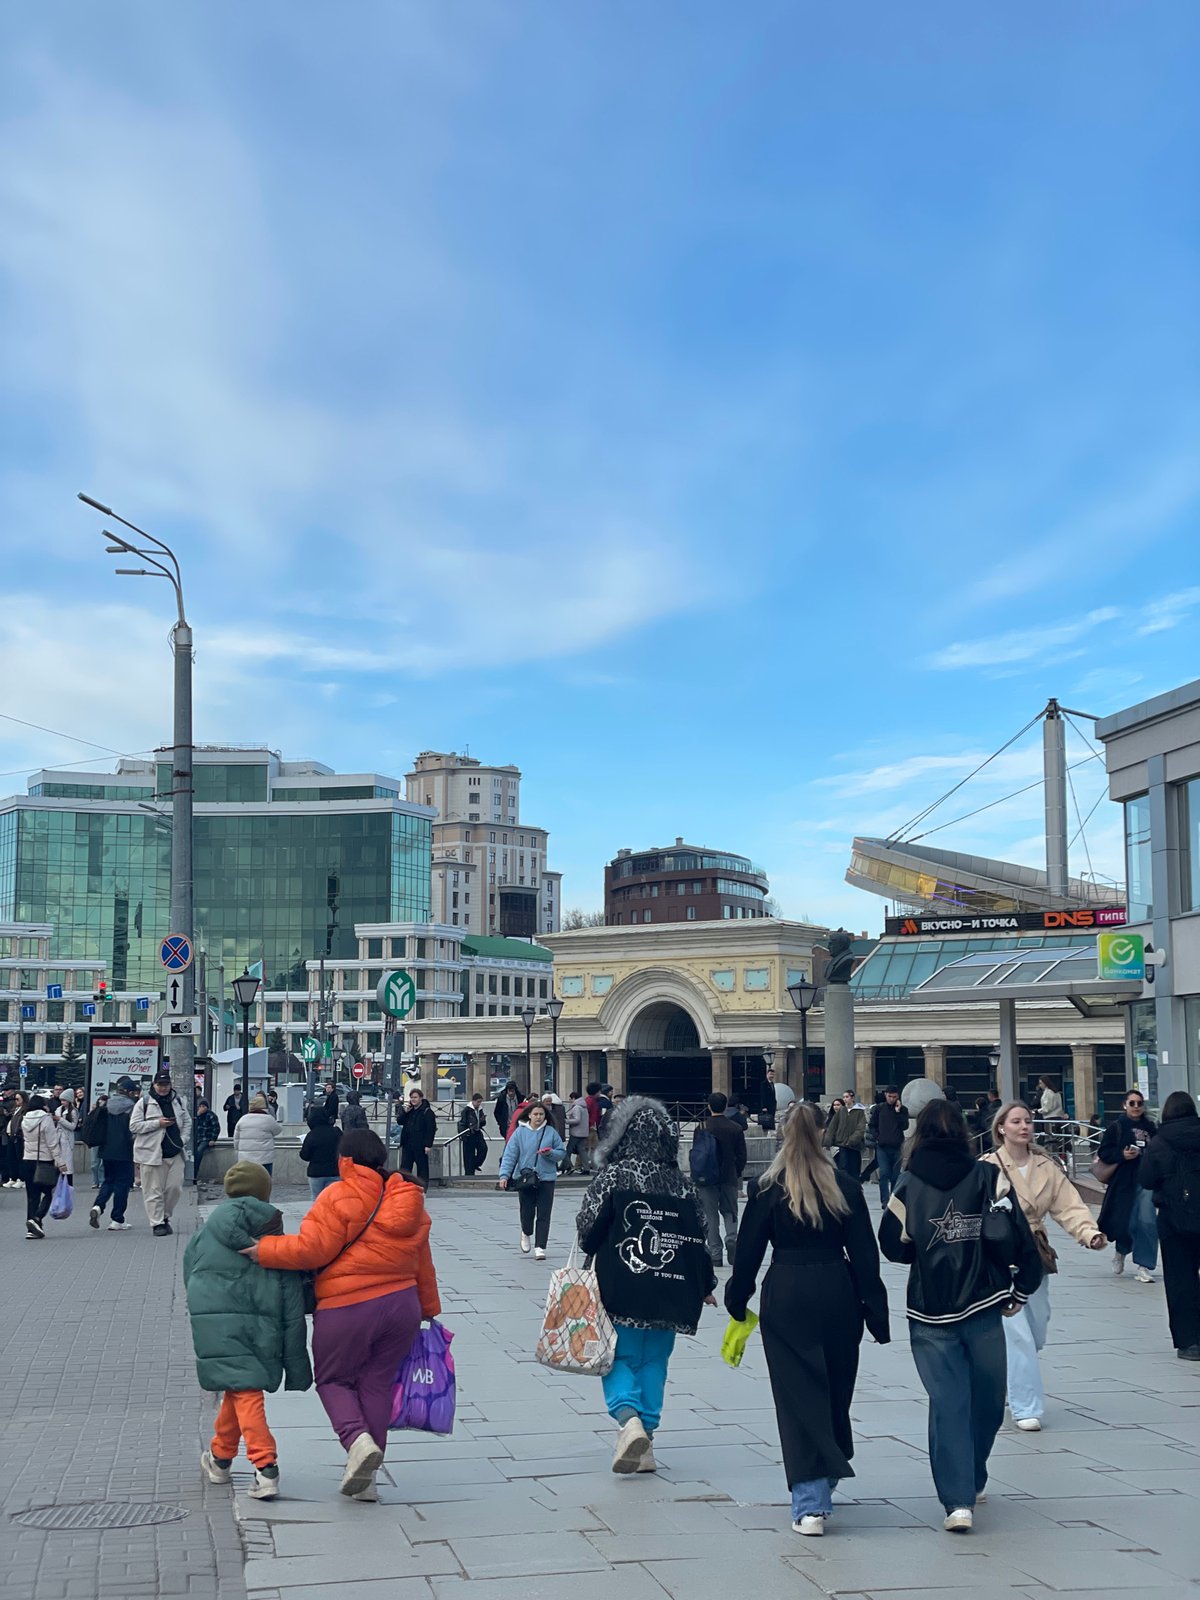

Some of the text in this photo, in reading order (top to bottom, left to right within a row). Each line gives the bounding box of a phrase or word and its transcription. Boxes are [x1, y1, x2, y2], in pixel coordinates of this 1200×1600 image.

[981, 918, 1018, 928] ТОЧКА
[1044, 911, 1094, 927] DNS
[1104, 966, 1141, 974] Банкомат
[128, 1064, 138, 1072] 10
[412, 1368, 434, 1384] WB
